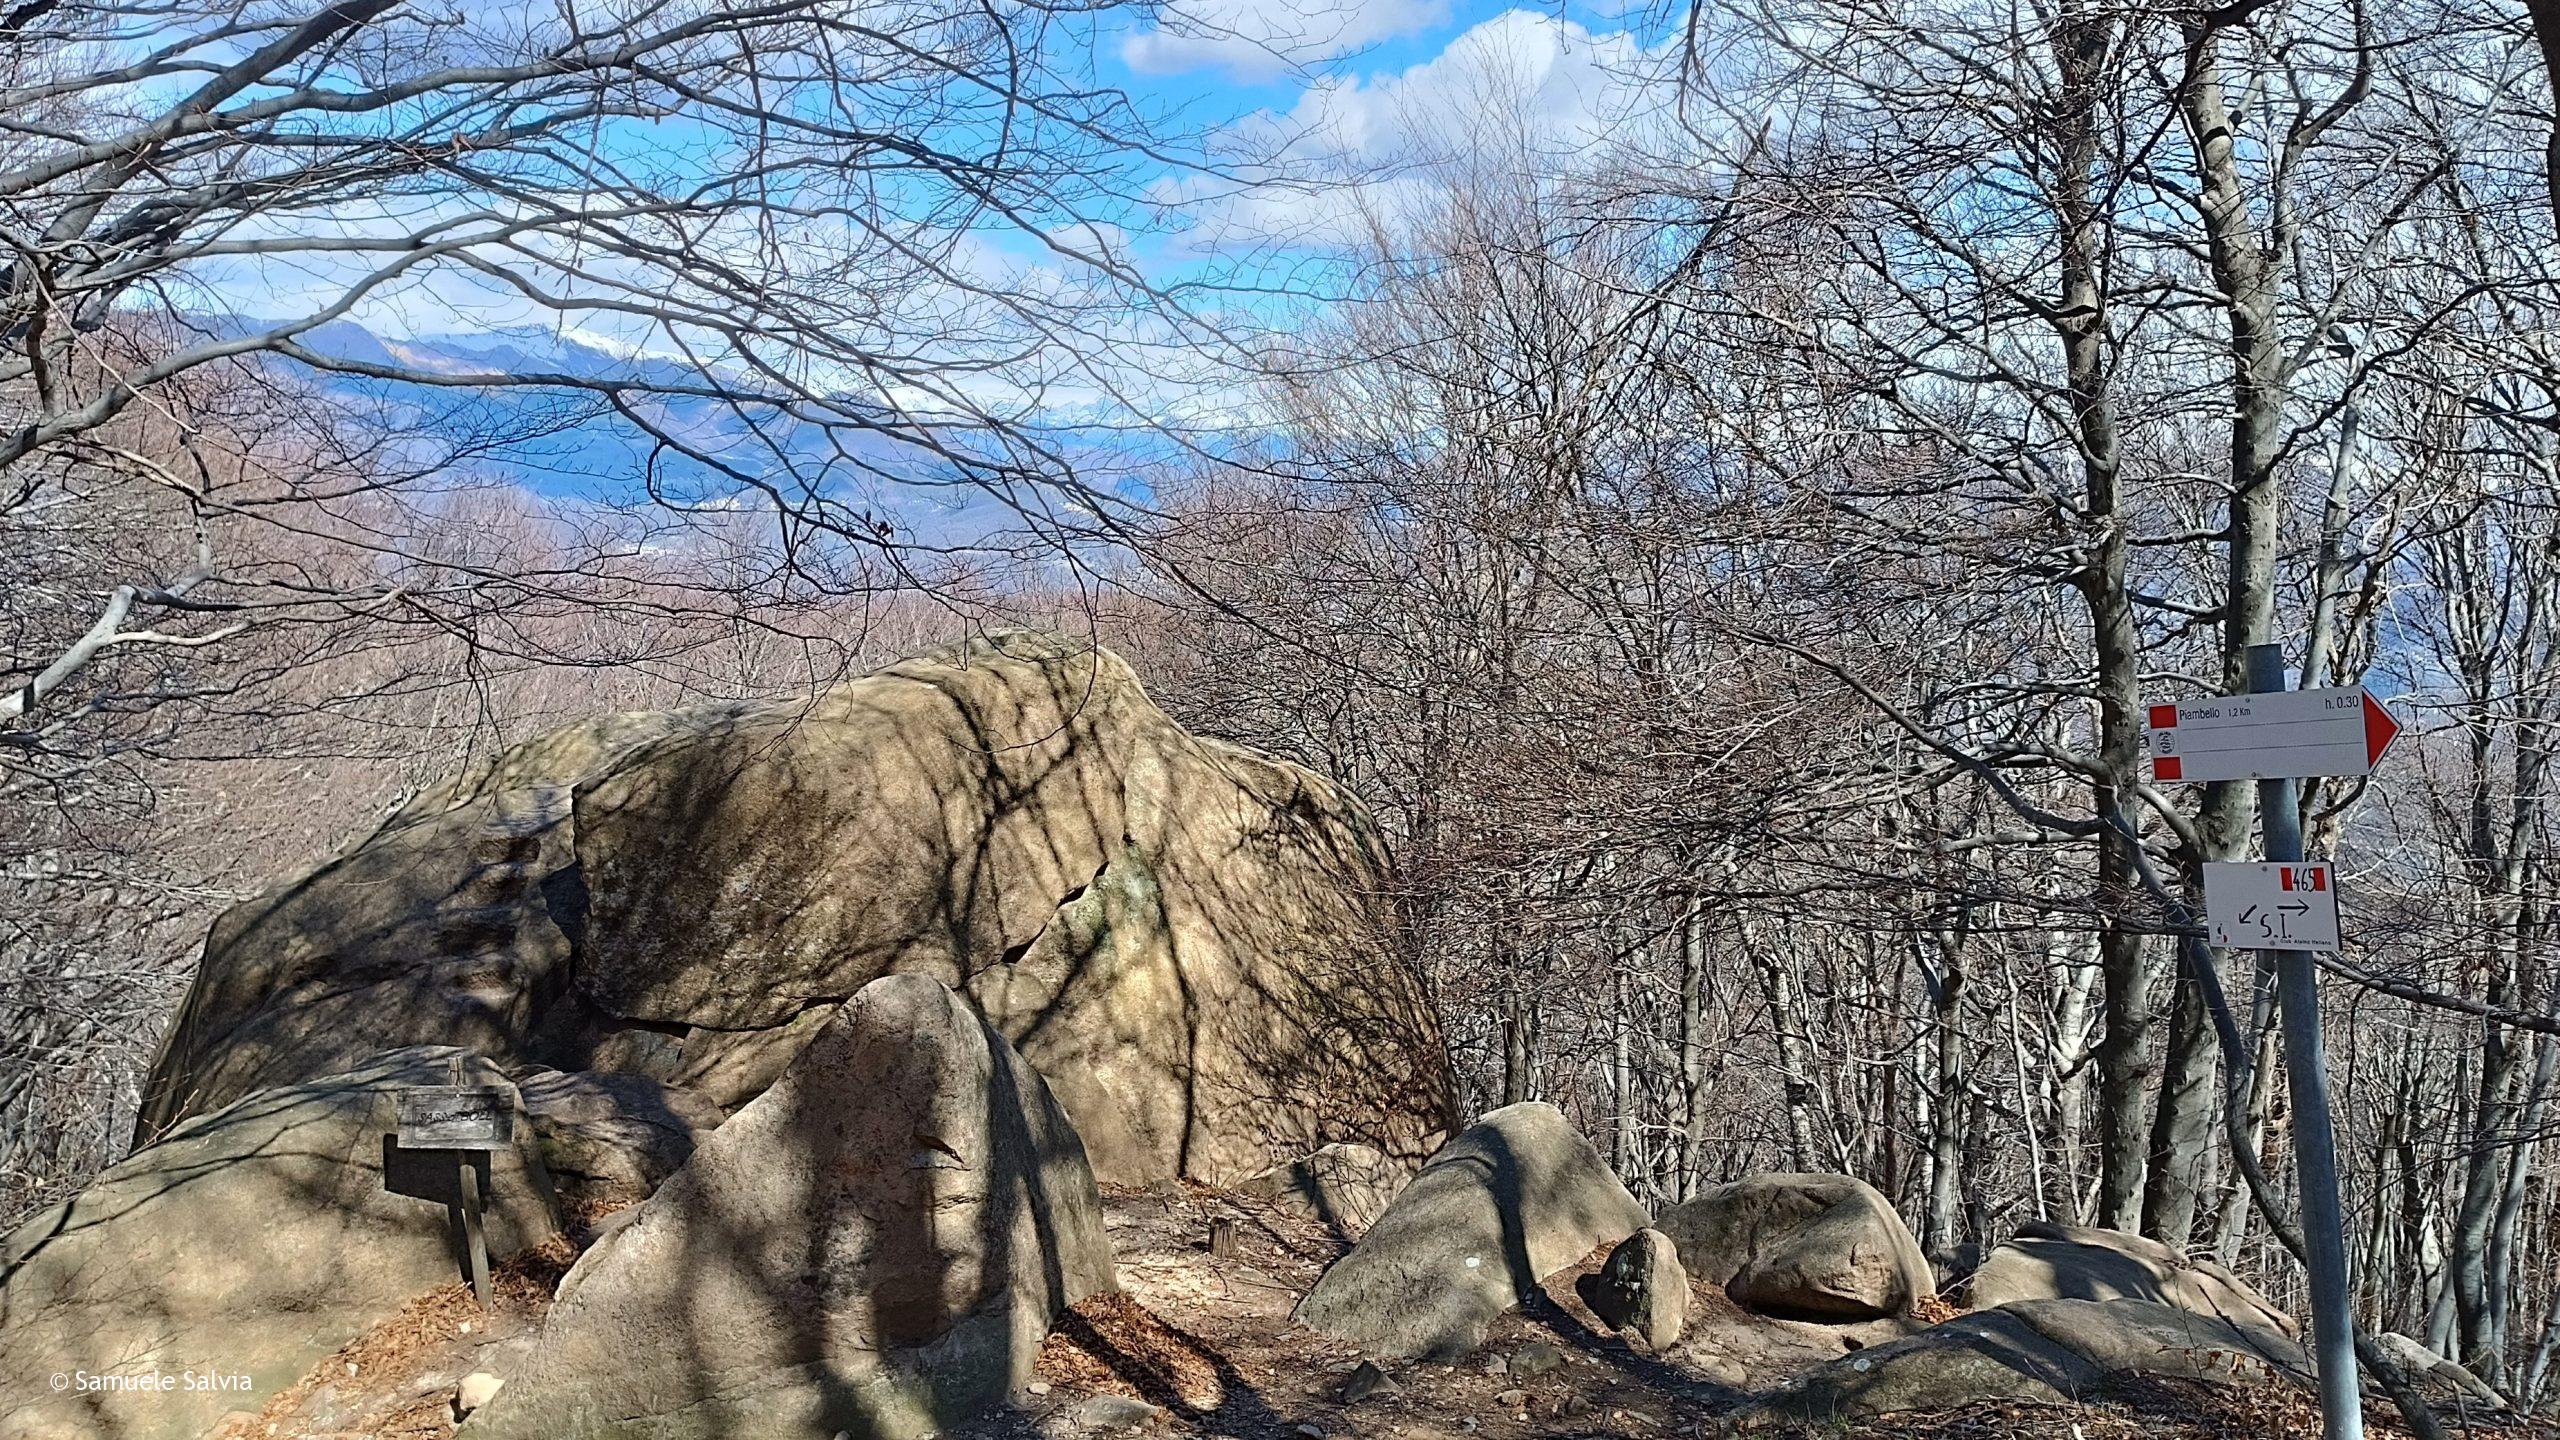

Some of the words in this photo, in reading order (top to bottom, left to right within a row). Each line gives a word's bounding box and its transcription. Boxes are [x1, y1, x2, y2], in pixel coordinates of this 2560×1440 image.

[2180, 707, 2220, 720] Piambello
[2239, 707, 2251, 716] Km
[2325, 697, 2335, 709] h.
[2336, 695, 2359, 708] 0.30
[2293, 867, 2315, 892] 465
[2260, 913, 2292, 938] S.I.
